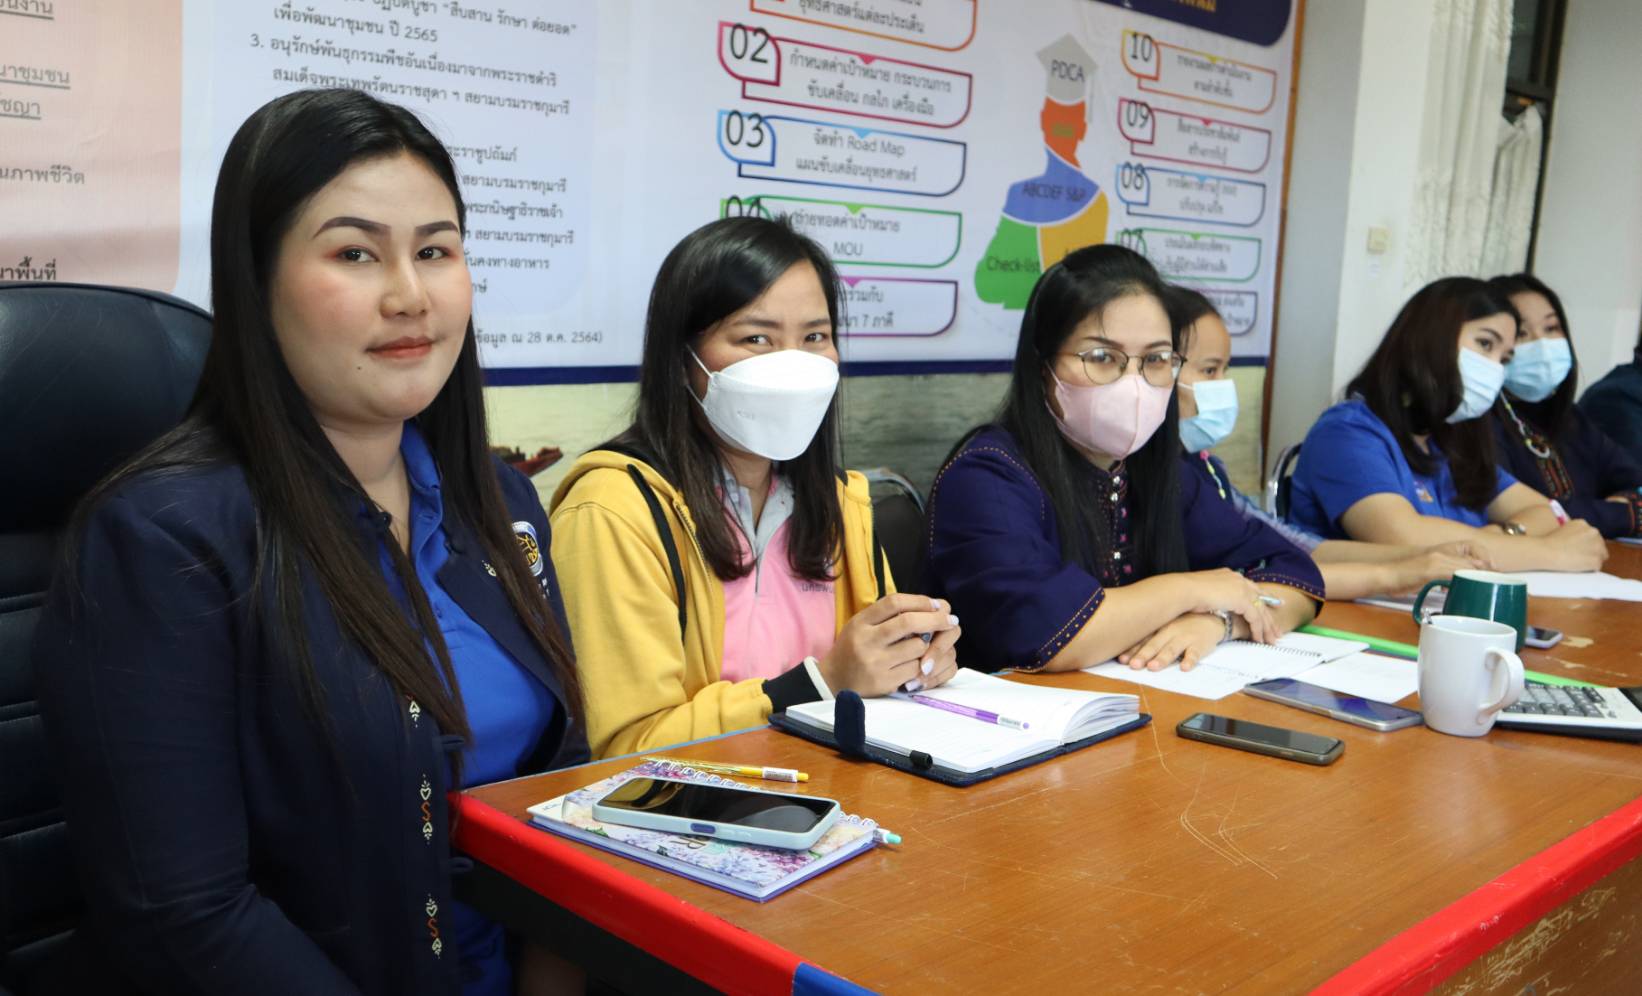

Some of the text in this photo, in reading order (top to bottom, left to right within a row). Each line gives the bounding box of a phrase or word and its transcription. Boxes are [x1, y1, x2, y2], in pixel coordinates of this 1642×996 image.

[273, 5, 439, 42] เพื่อพัฒนาชุมชน ปี 2565
[250, 34, 265, 49] 3.
[729, 23, 770, 64] 02
[1130, 32, 1153, 63] 10
[1051, 59, 1085, 83] PDCA
[725, 109, 765, 149] 03
[1126, 100, 1150, 129] 09
[847, 135, 877, 153] Road
[880, 140, 906, 159] Map
[1121, 162, 1145, 191] 08
[833, 241, 864, 257] MOU
[527, 332, 542, 344] 28
[571, 331, 603, 345] 2564)
